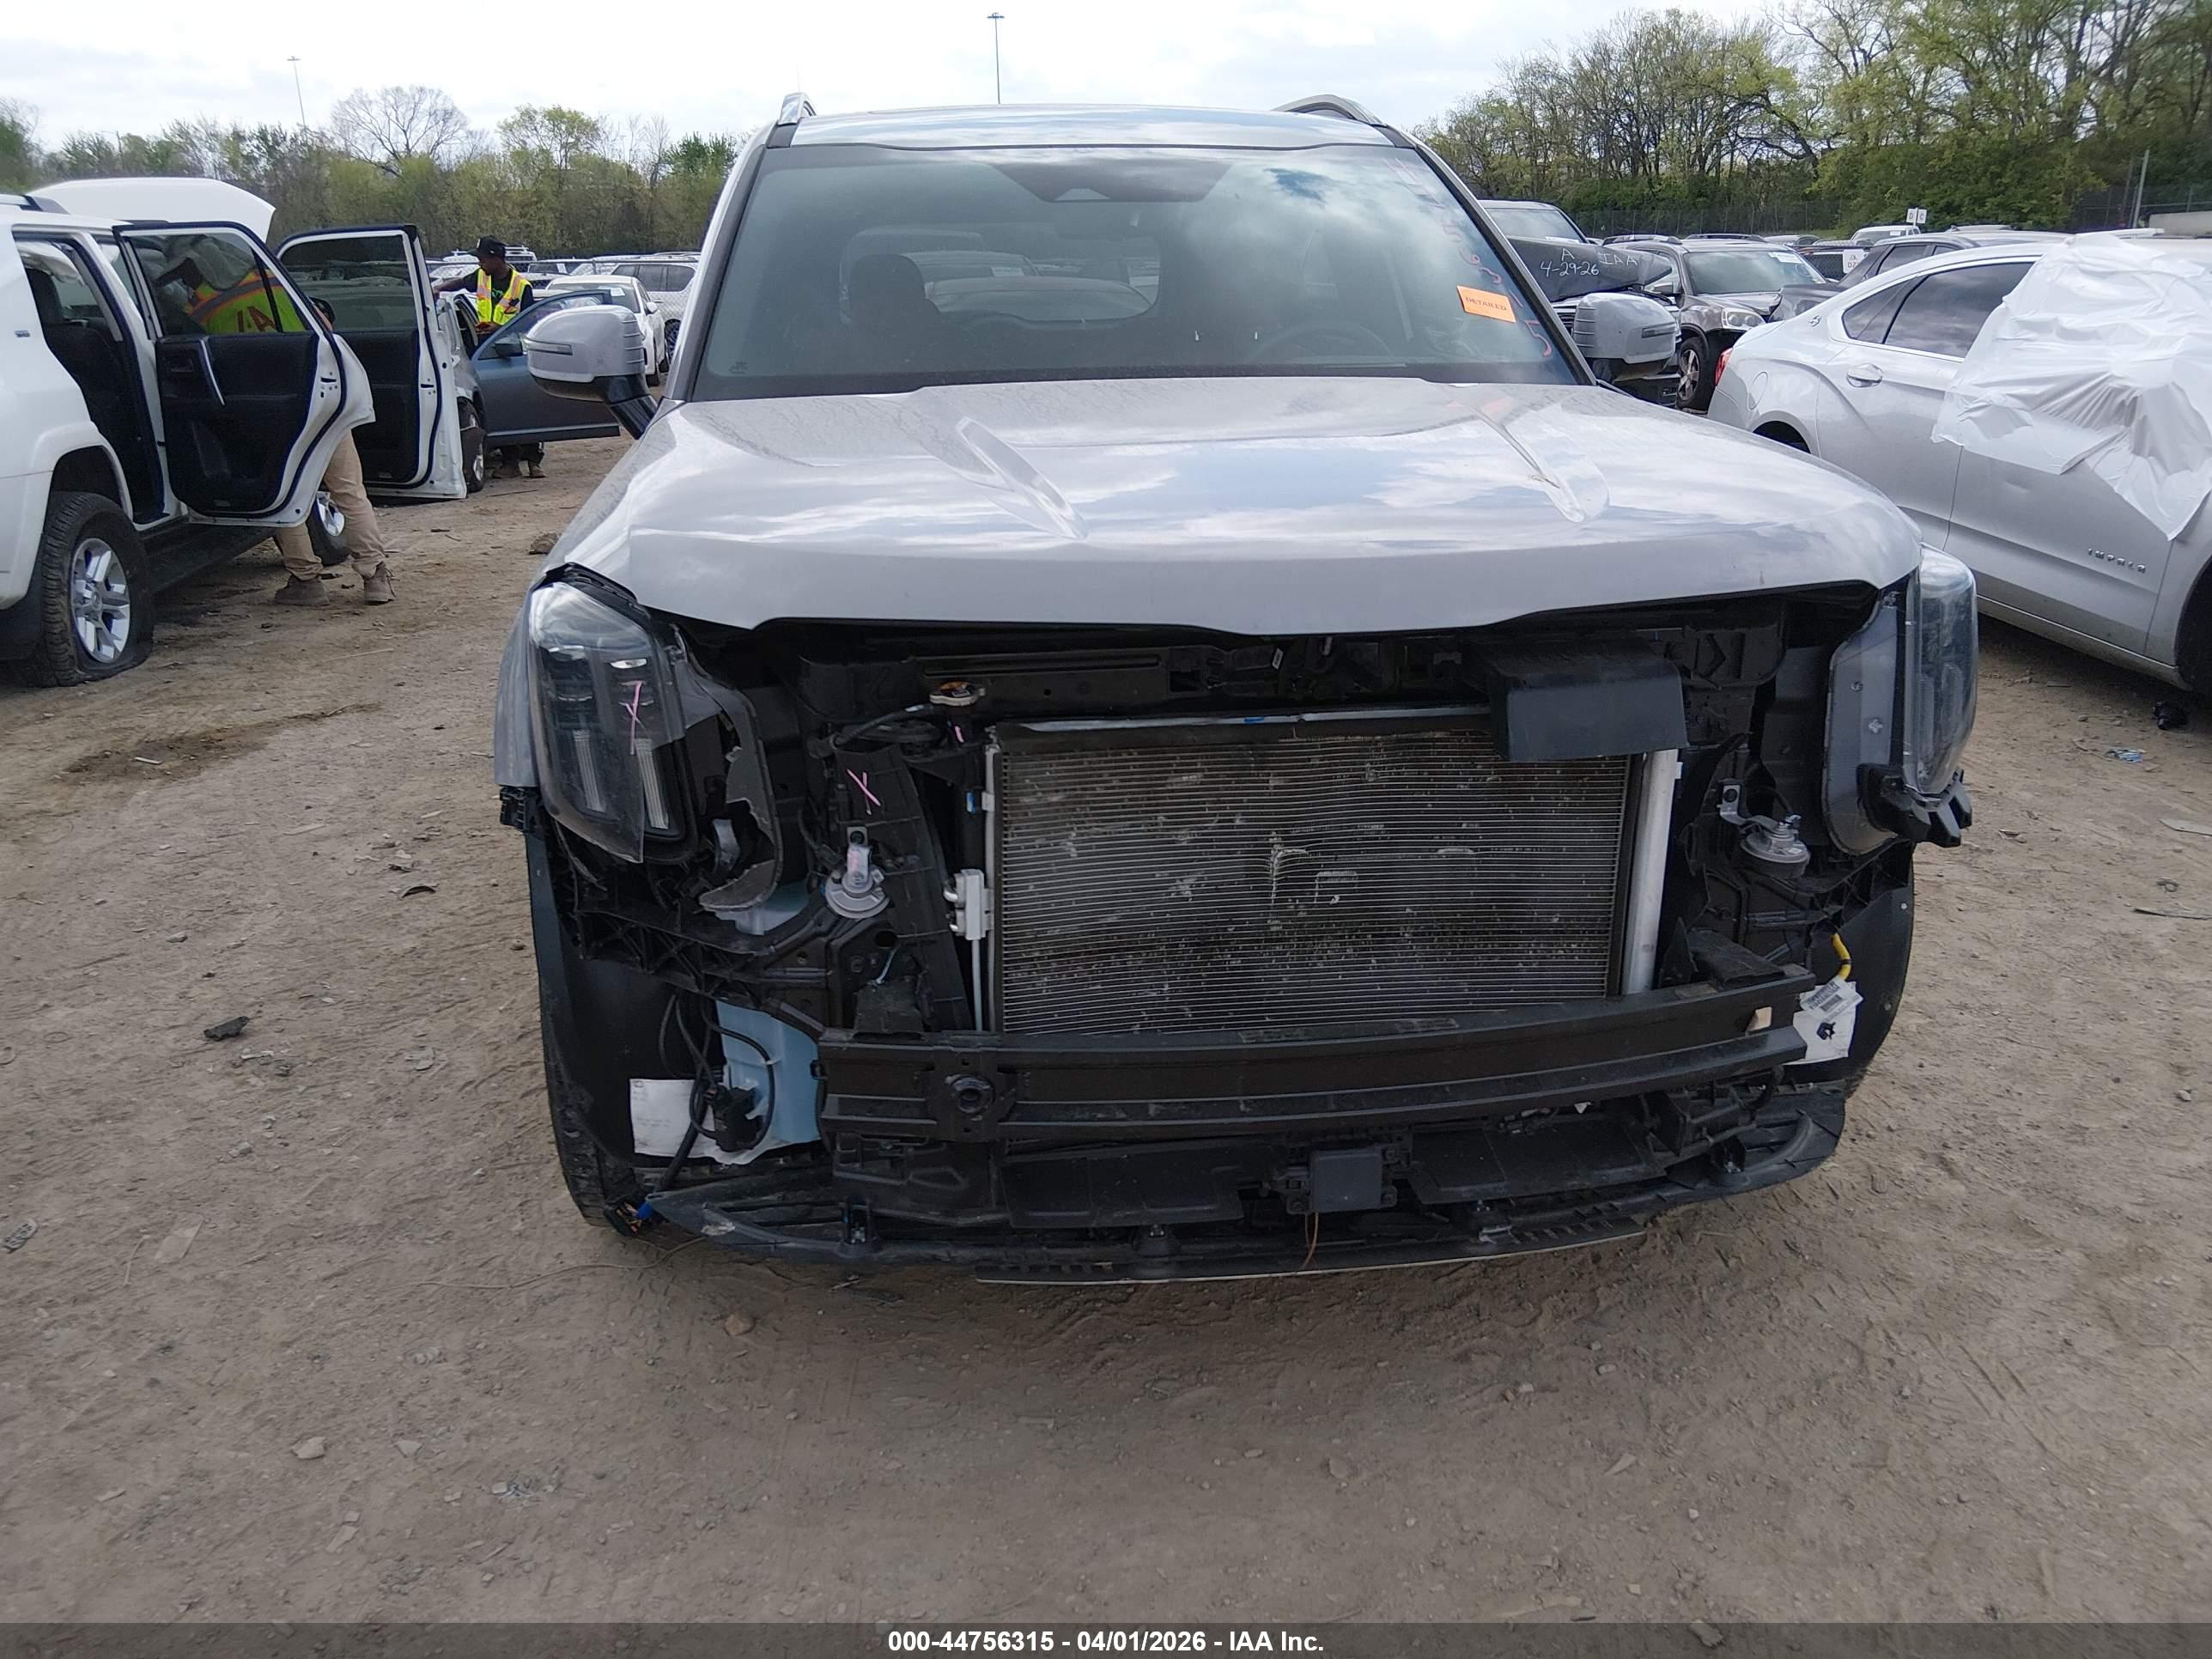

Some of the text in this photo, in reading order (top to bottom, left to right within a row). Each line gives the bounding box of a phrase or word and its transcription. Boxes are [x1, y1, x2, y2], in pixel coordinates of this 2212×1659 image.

[1561, 247, 1575, 261] A
[1598, 252, 1638, 266] IAA
[1540, 260, 1600, 277] 4-29-26
[2087, 548, 2146, 574] IMPALA
